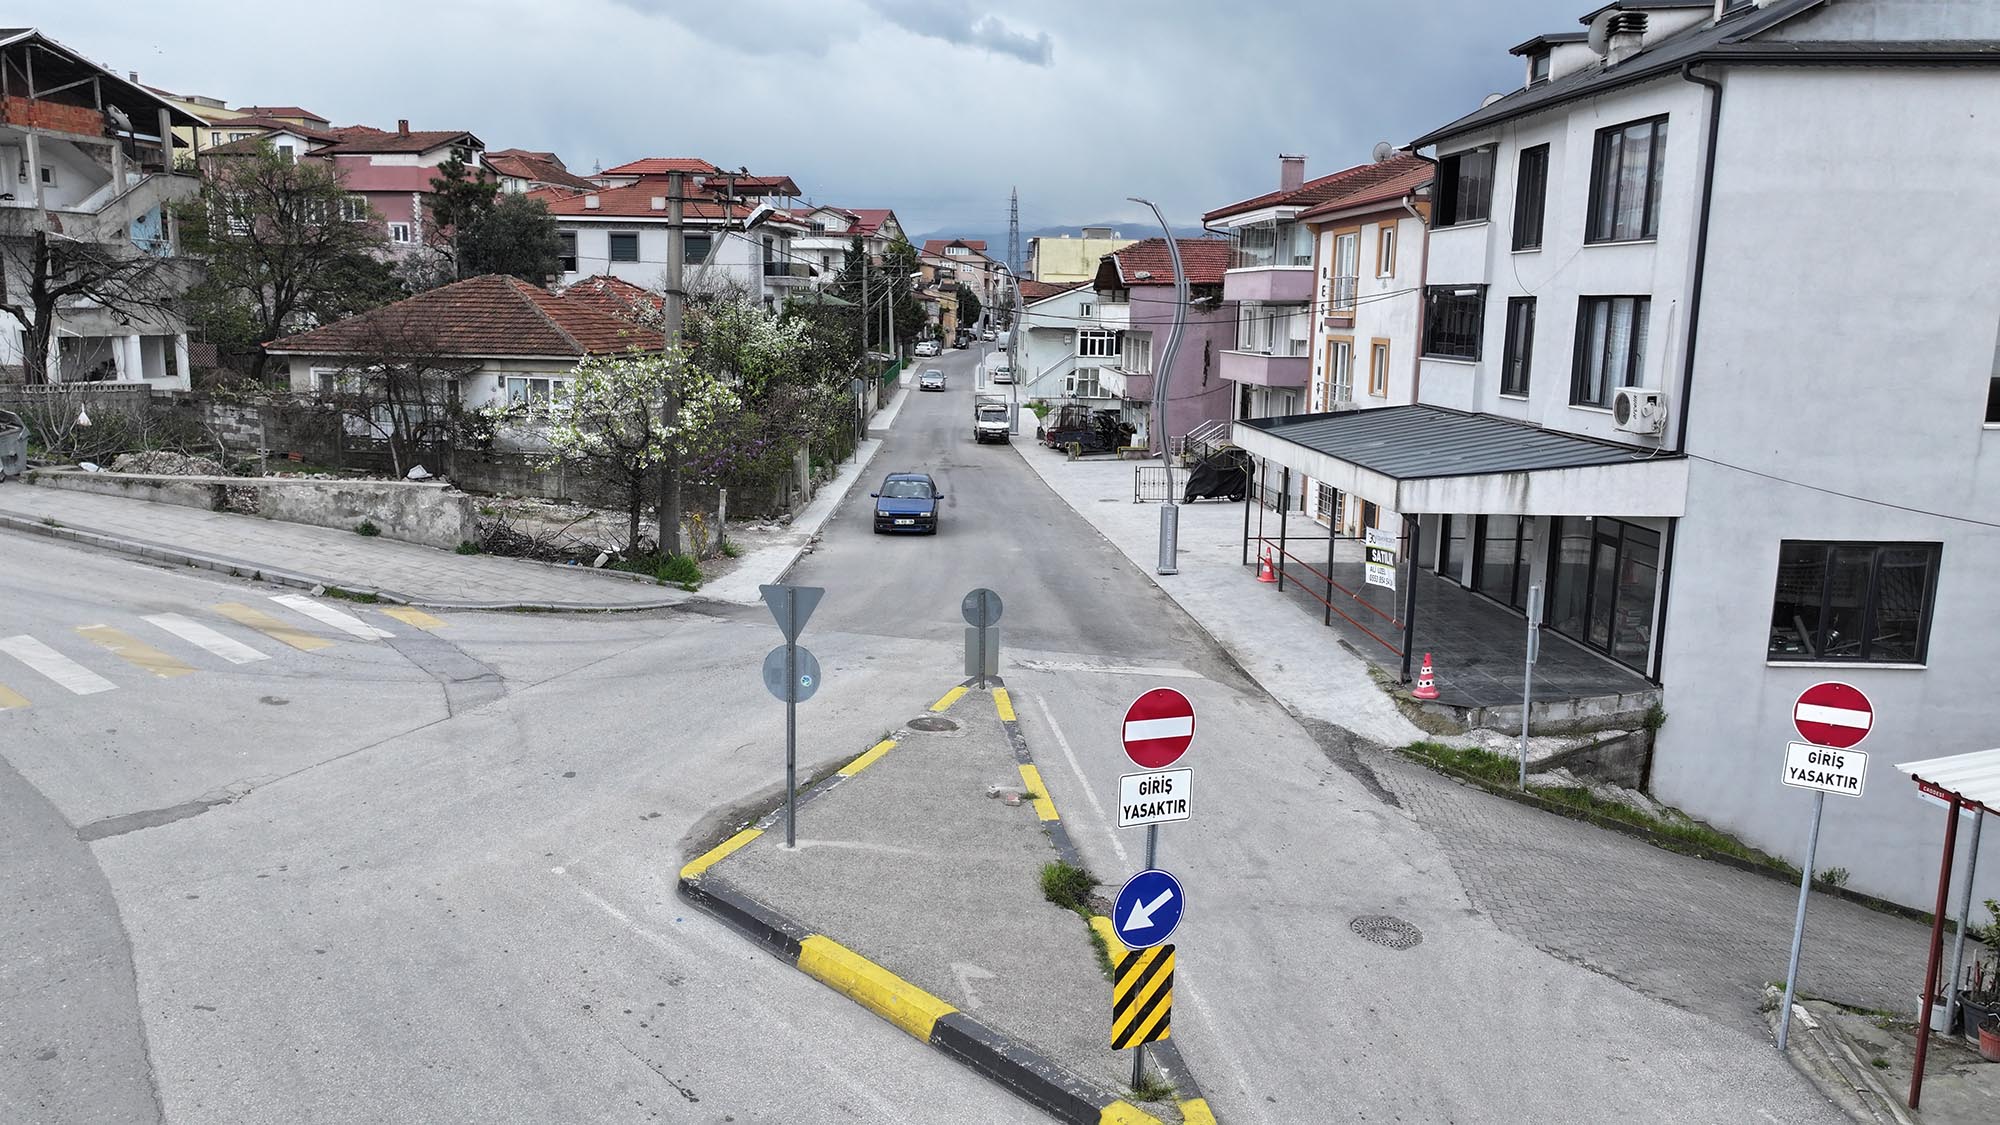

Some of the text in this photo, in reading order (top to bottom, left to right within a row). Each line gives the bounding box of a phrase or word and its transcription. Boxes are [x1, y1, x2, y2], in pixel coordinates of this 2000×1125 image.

[1808, 749, 1845, 769] GİRİŞ
[1139, 775, 1173, 796] GİRİŞ
[1790, 766, 1858, 789] YASAKTIR
[1123, 799, 1186, 820] YASAKTIR
